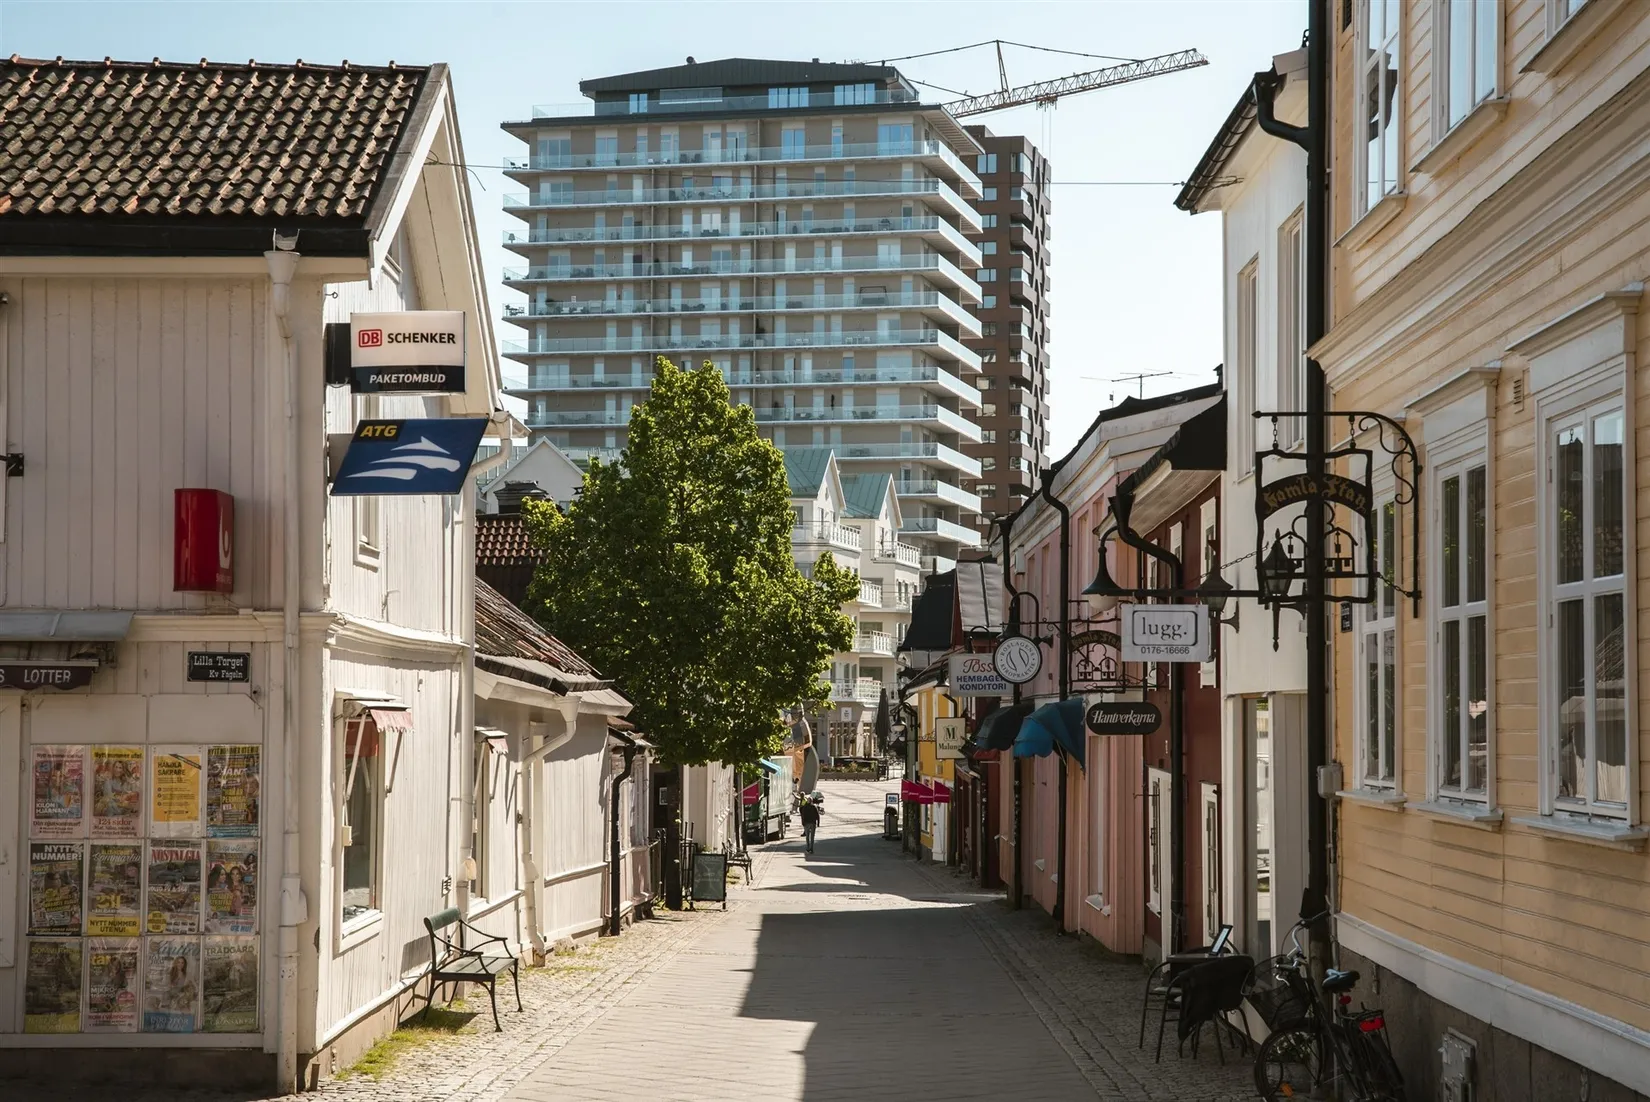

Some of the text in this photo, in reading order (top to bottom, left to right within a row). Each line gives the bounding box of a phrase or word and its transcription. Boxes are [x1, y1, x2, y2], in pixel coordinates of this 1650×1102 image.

[361, 331, 456, 345] DB SCHENKER
[369, 373, 446, 384] PAKETOMBUD
[360, 424, 397, 437] ATG
[1142, 617, 1187, 641] lugg.
[1000, 641, 1035, 657] ROSLAGENS
[194, 655, 243, 670] Lilla Torget
[963, 658, 994, 674] Töss
[23, 669, 71, 683] LOTTER
[209, 669, 219, 678] Kv
[1000, 663, 1035, 678] KIROPRAKTIK
[960, 683, 1007, 691] KONDITORI
[1091, 709, 1156, 726] Hantverkarna
[945, 727, 957, 740] M
[44, 844, 71, 853] NYTT
[151, 848, 201, 862] NOSTALGIA
[32, 852, 82, 861] NUMMER!
